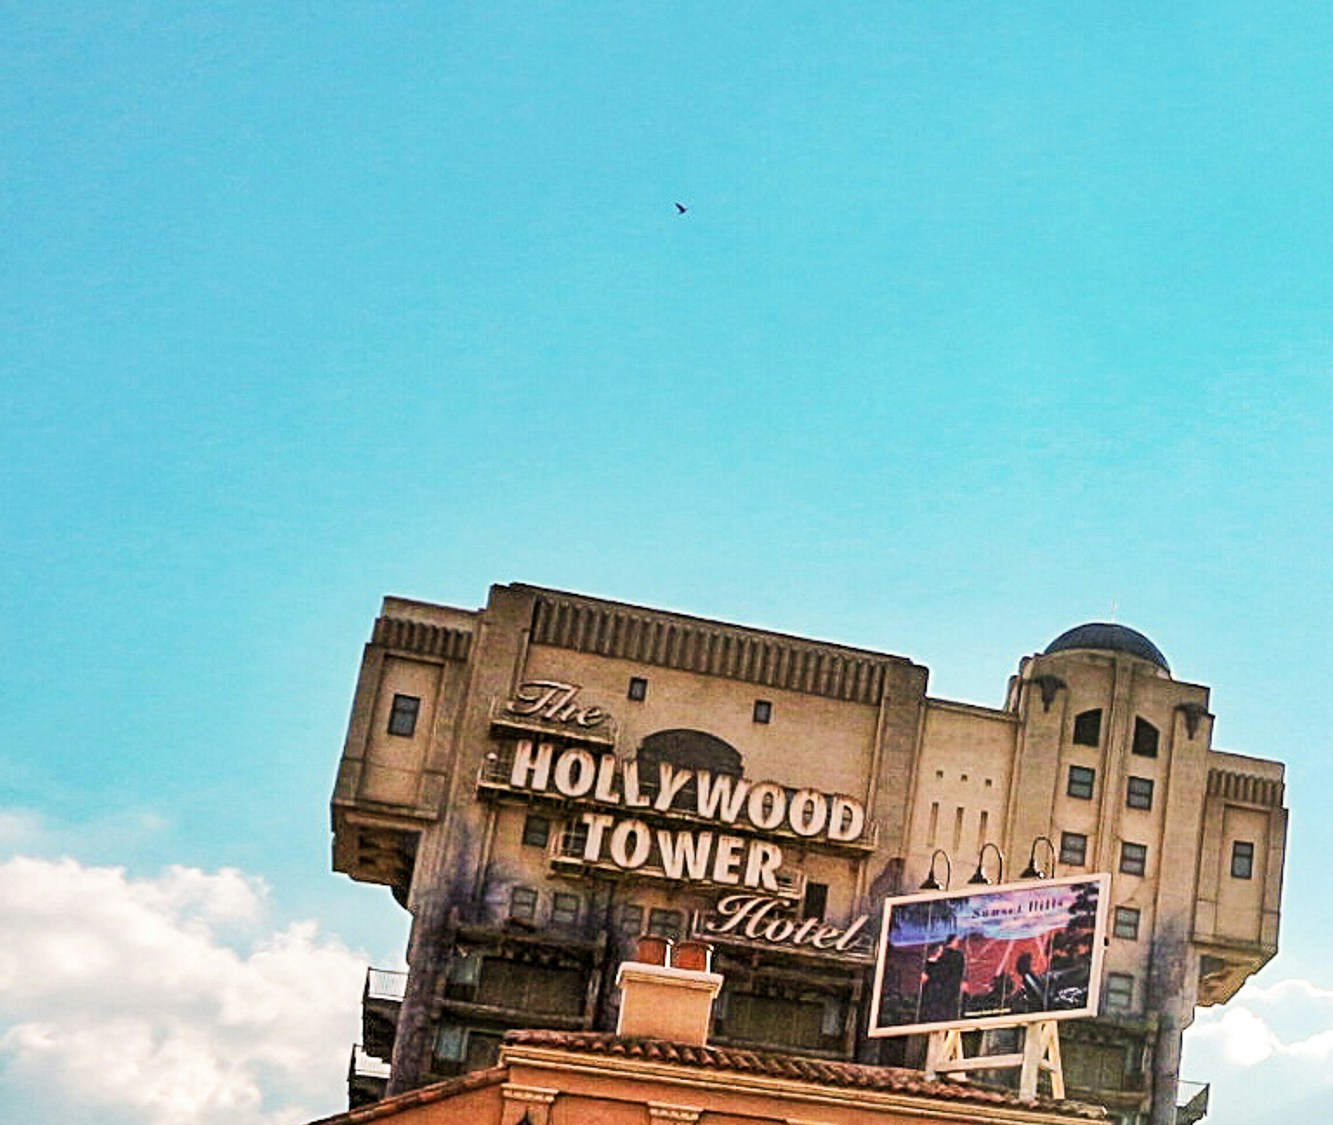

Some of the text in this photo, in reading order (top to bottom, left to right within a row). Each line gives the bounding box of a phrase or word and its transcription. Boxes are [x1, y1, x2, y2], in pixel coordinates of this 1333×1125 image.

[506, 679, 604, 728] The
[509, 738, 866, 842] HOLLYWOOD
[582, 812, 783, 892] TOWER
[706, 894, 869, 952] Hotel
